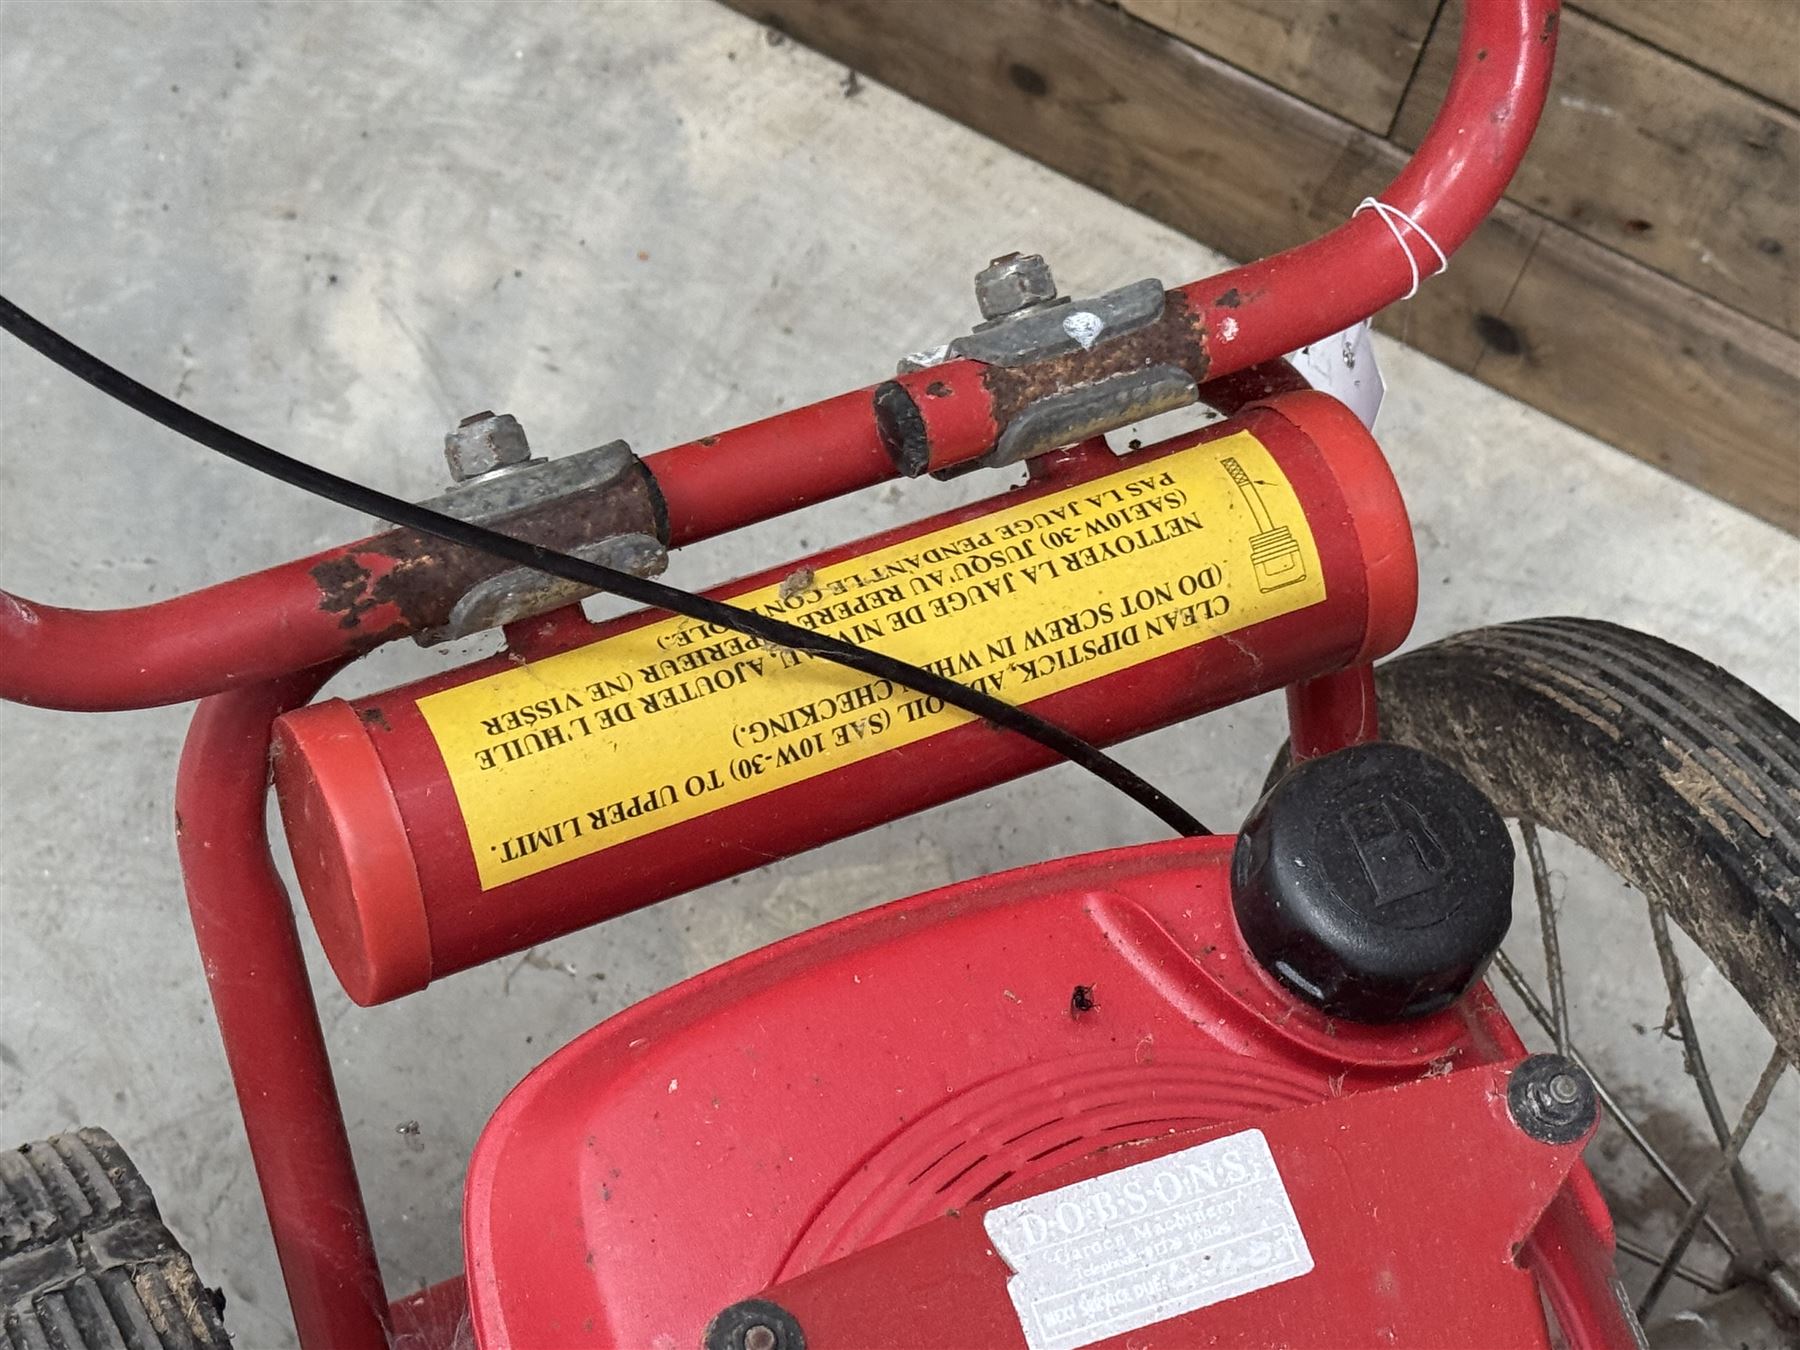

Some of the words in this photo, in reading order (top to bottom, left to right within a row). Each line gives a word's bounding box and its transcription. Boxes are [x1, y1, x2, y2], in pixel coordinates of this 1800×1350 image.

[1085, 489, 1125, 508] LA
[1125, 472, 1175, 497] PAS
[995, 501, 1081, 540] JAUGE
[1040, 490, 1187, 549] (SAE10W-30)
[871, 532, 994, 583] PENDANT
[1060, 516, 1204, 572] NETTOYER
[826, 574, 866, 596] LE
[1020, 560, 1060, 585] LA
[1178, 564, 1222, 596] (DO
[795, 584, 906, 638] REPERE
[928, 572, 1016, 618] JAUGE
[1120, 586, 1174, 618] NOT
[656, 585, 823, 650] CONOLE.)
[886, 604, 927, 632] DE
[1025, 602, 1114, 651] SCREW
[1145, 595, 1230, 640] CLEAN
[637, 620, 793, 683] PERIEUR
[986, 636, 1017, 664] IN
[1009, 624, 1141, 683] DIPSTICK,
[585, 673, 634, 702] (NE
[638, 657, 763, 714] AJOUTER
[897, 689, 947, 723] OIL
[961, 670, 1004, 702] AD
[480, 693, 584, 736] VISSER
[594, 702, 636, 730] DE
[732, 673, 894, 748] CHECKING.)
[831, 708, 891, 747] (SAE
[474, 716, 592, 771] L'HUILE
[729, 732, 826, 781] 10W-30)
[684, 769, 725, 797] TO
[586, 785, 679, 830] UPPER
[490, 816, 583, 864] LIMIT.
